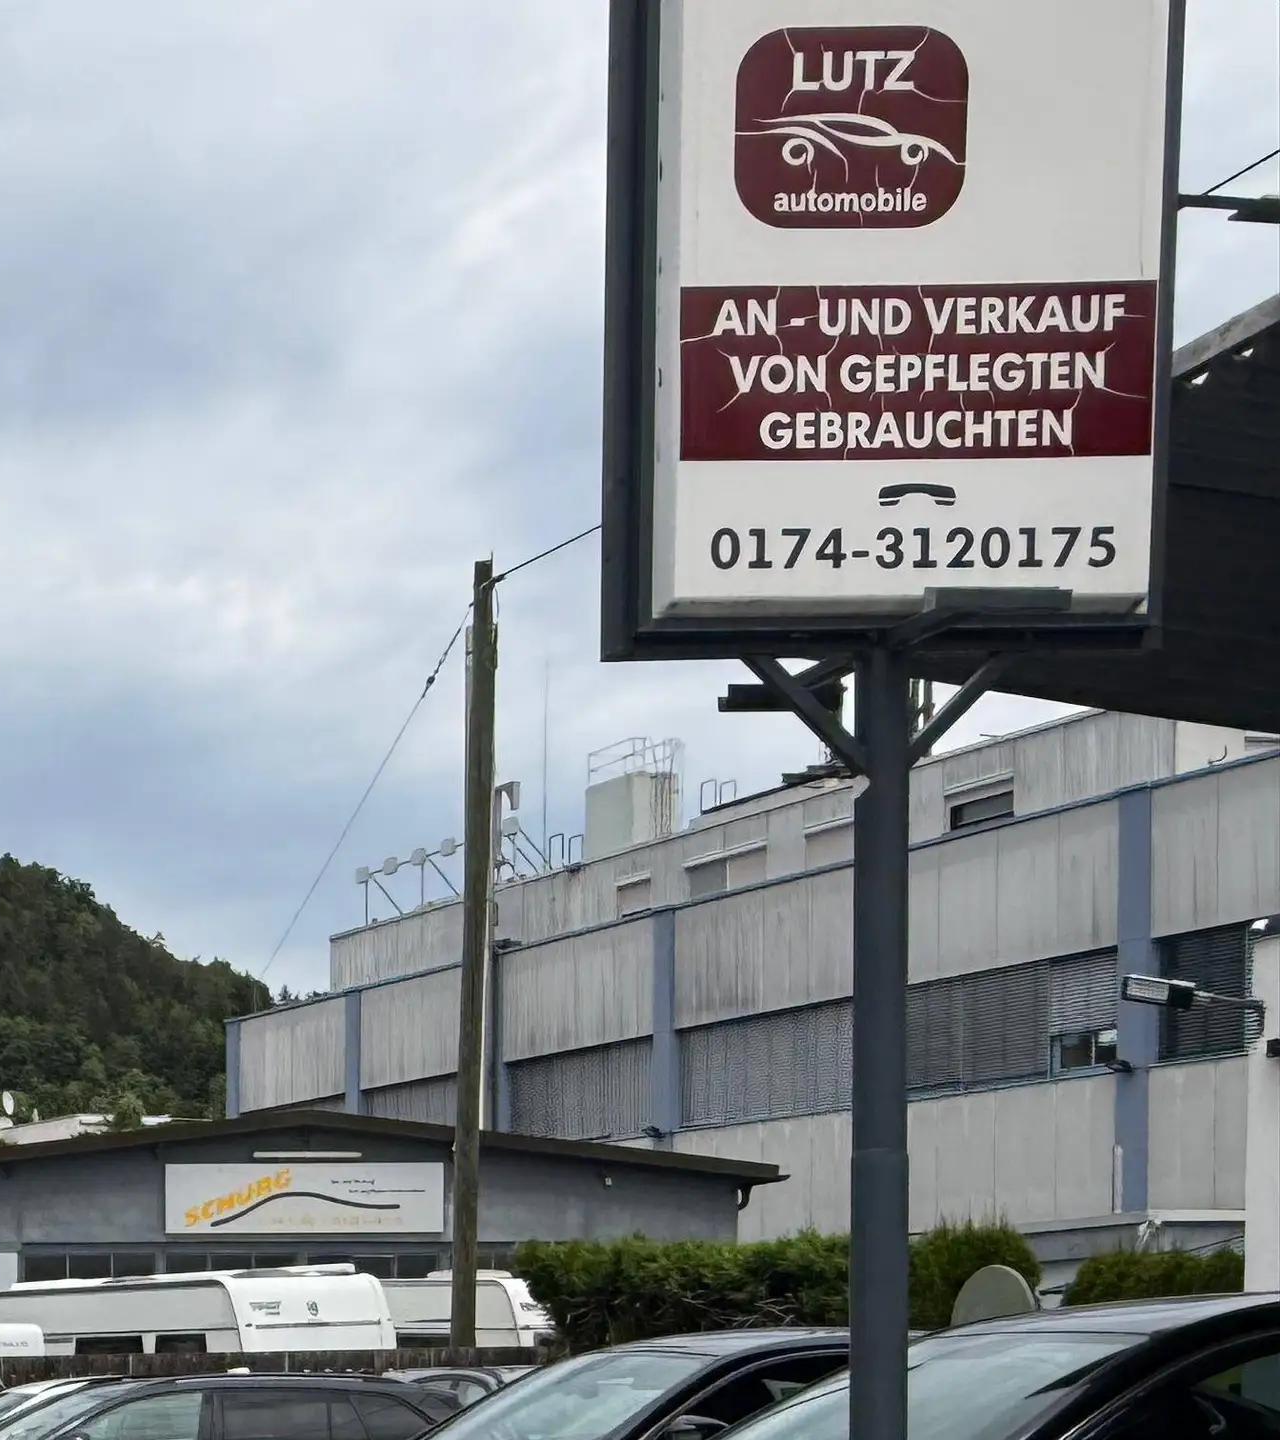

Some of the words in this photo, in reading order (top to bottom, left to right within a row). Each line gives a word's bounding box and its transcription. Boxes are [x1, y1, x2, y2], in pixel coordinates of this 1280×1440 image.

[792, 50, 916, 92] LUTZ
[773, 187, 928, 213] automobile
[817, 296, 913, 336] UND
[929, 293, 1127, 334] VERKAUF
[729, 353, 828, 393] VON
[839, 350, 1107, 392] GEPFLEGTEN
[758, 409, 1074, 449] GEBRAUCHTEN
[710, 525, 1117, 570] 0174-3120175
